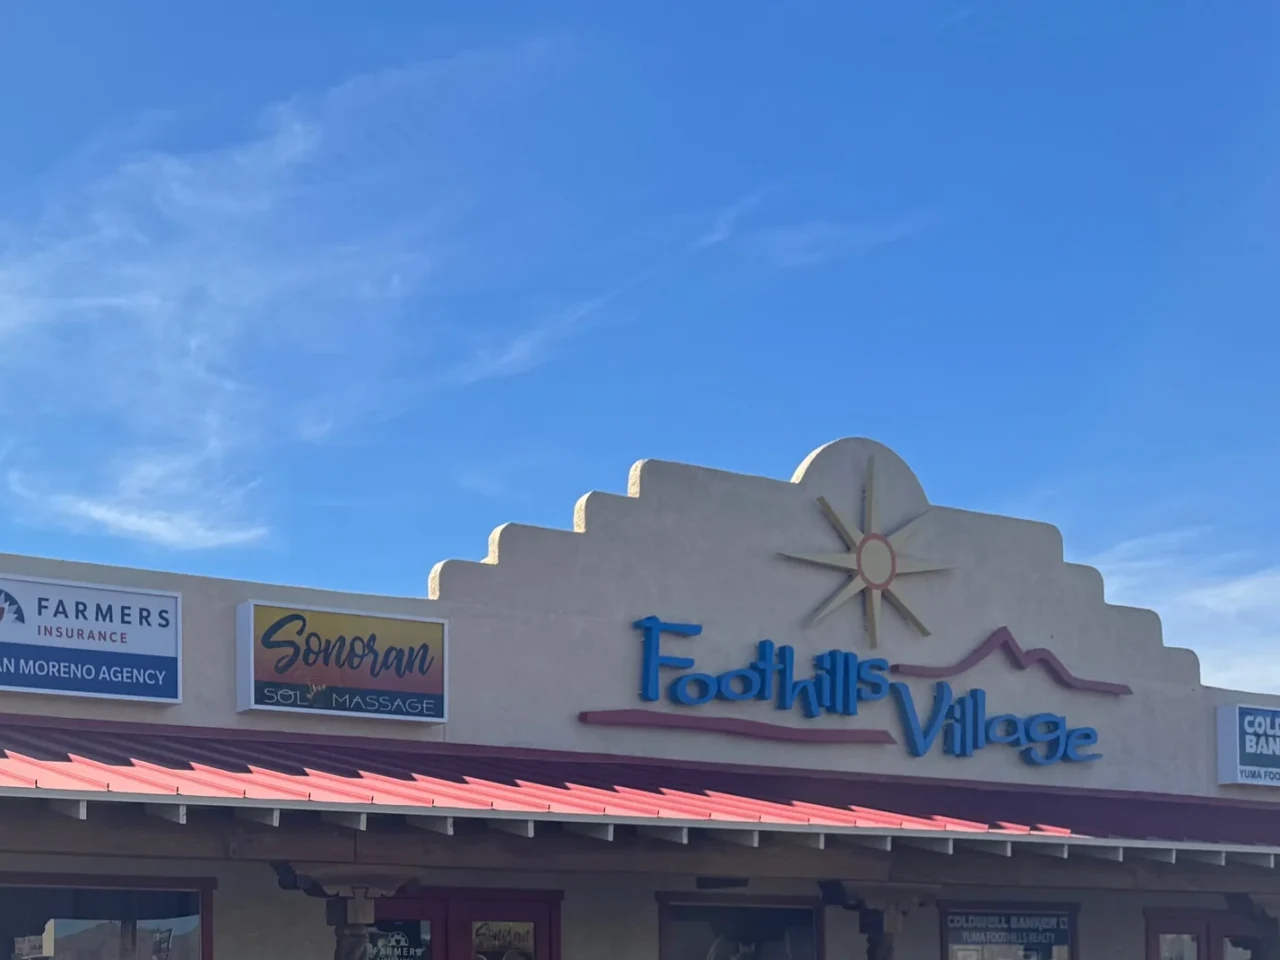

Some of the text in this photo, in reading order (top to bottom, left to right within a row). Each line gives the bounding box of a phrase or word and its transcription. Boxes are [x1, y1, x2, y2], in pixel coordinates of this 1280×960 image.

[37, 597, 171, 628] FARMERS
[37, 624, 128, 644] INSURANCE
[261, 613, 435, 679] Sonoran
[19, 658, 95, 680] MORENO
[98, 665, 166, 686] AGENCY
[632, 615, 891, 719] Foothills
[264, 687, 436, 715] SOL MASSAGE
[890, 681, 1104, 766] Village
[1239, 769, 1262, 779] YUMA
[948, 916, 1058, 929] COLDWELL BANKER
[961, 931, 985, 943] YUMA
